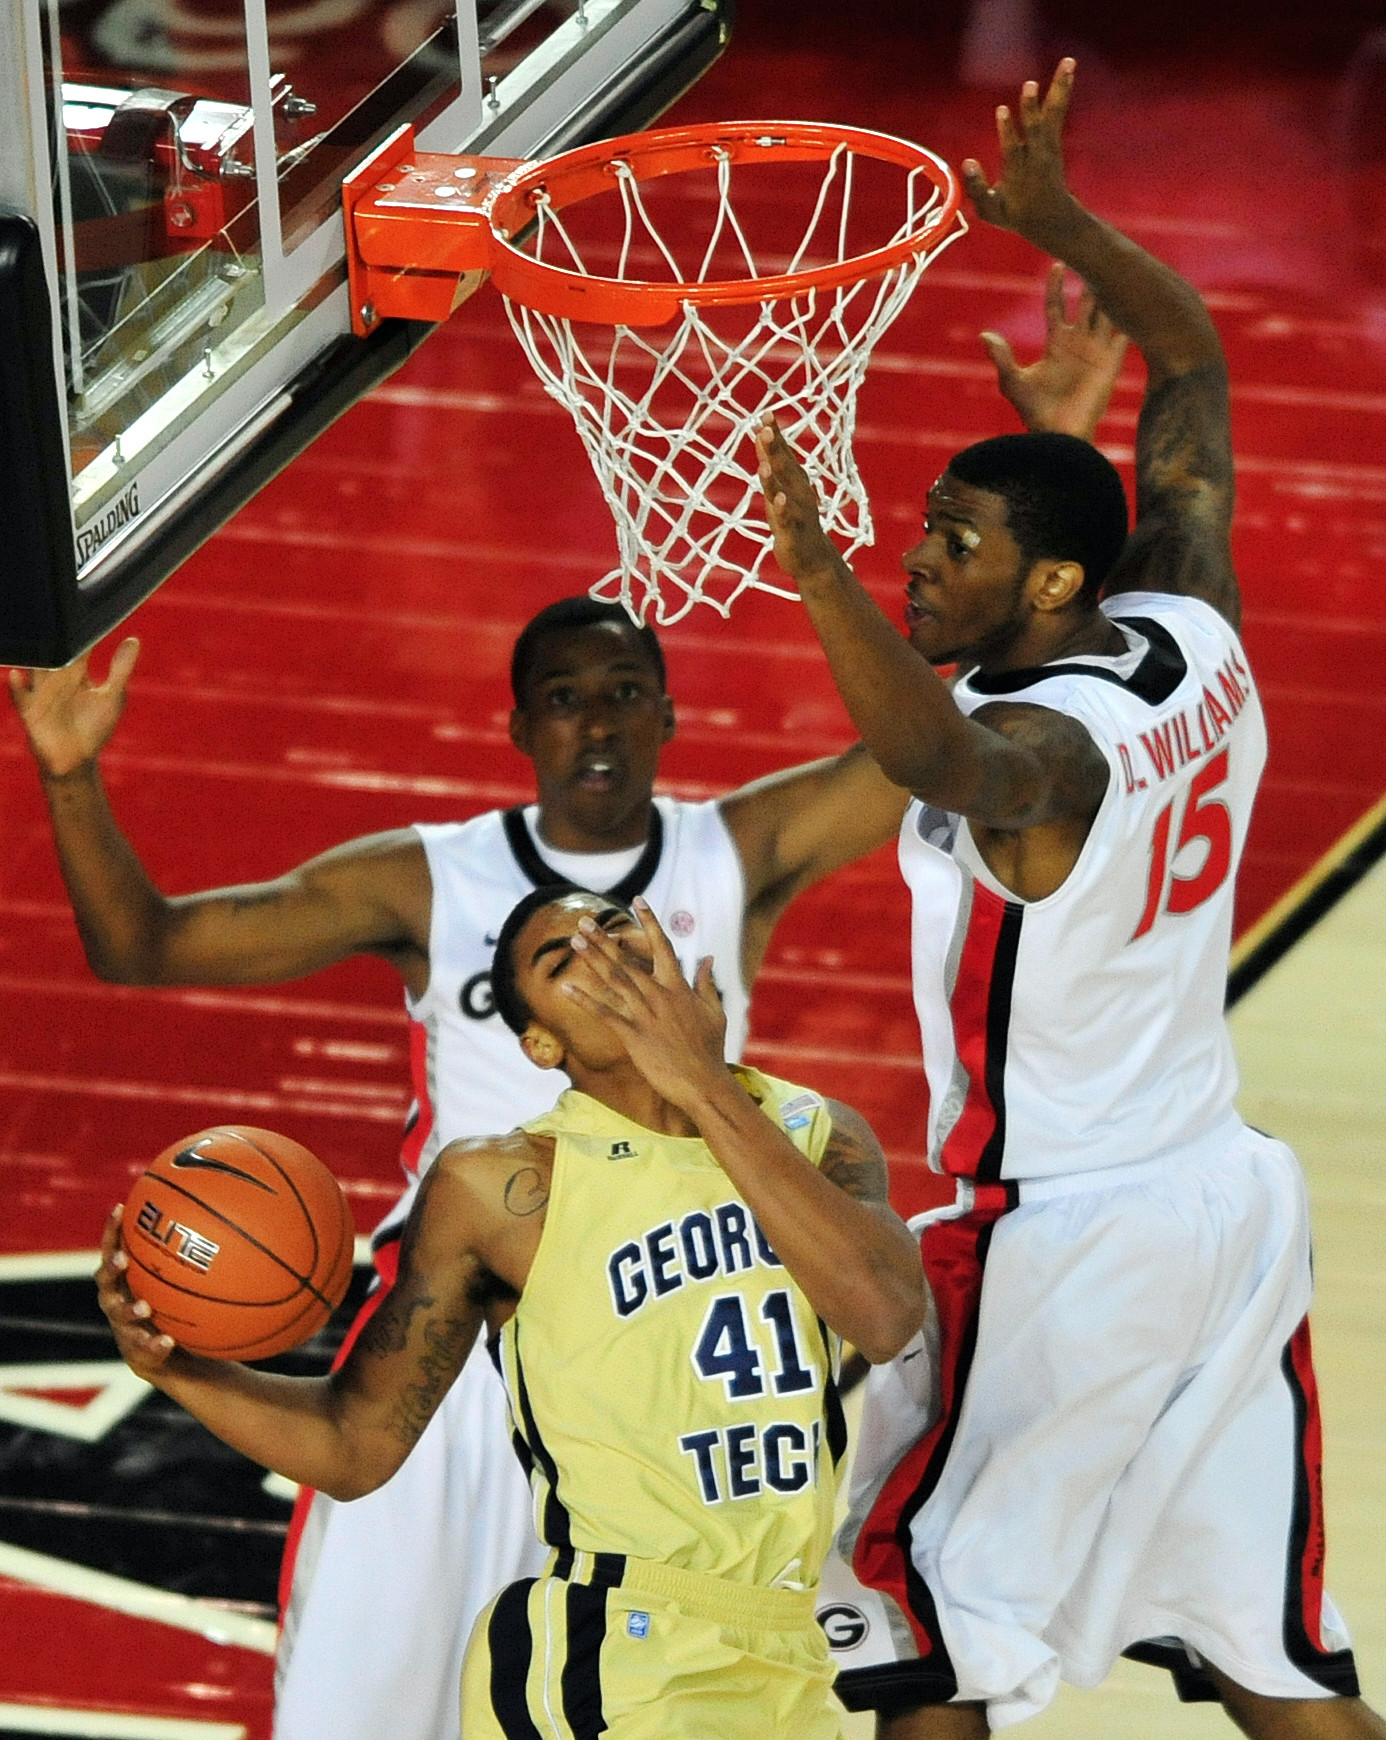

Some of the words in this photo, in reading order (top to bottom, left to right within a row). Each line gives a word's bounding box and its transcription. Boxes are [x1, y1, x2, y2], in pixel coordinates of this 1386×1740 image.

[76, 481, 139, 570] SPALDING
[1116, 742, 1149, 795] D.
[1137, 646, 1250, 782] WILLAMS
[1126, 742, 1233, 946] 15
[137, 1200, 221, 1272] ELITE
[689, 1287, 817, 1404] 41
